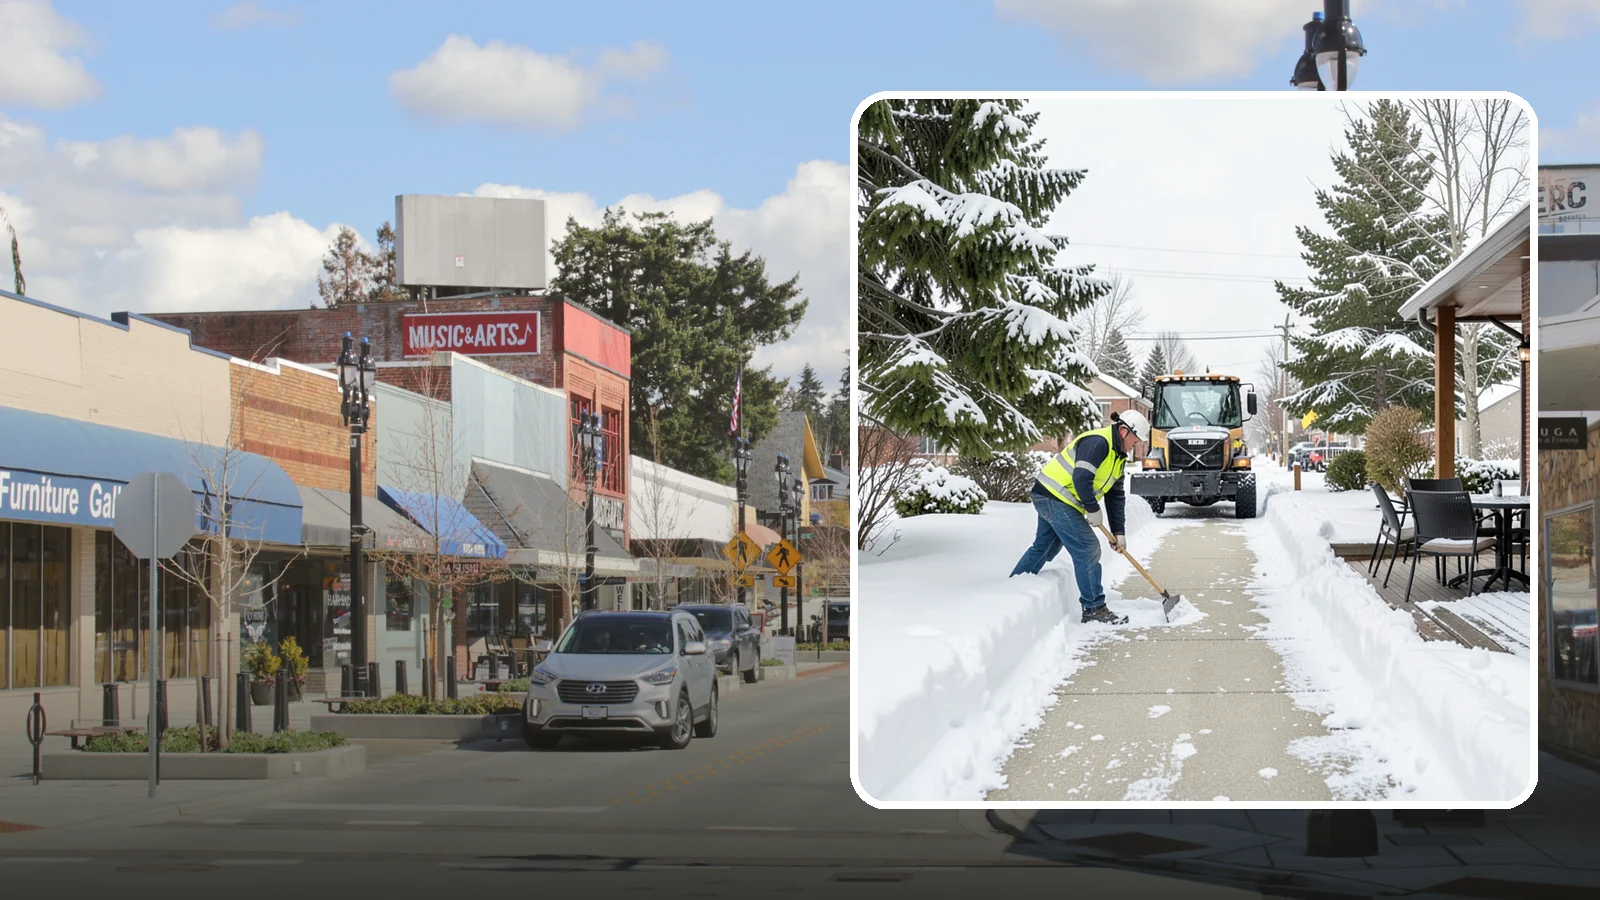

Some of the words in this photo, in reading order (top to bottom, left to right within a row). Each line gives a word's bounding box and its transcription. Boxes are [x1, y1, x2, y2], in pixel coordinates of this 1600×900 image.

[0, 472, 79, 515] Furniture
[90, 483, 122, 519] Gal
[453, 563, 479, 574] SUSHI
